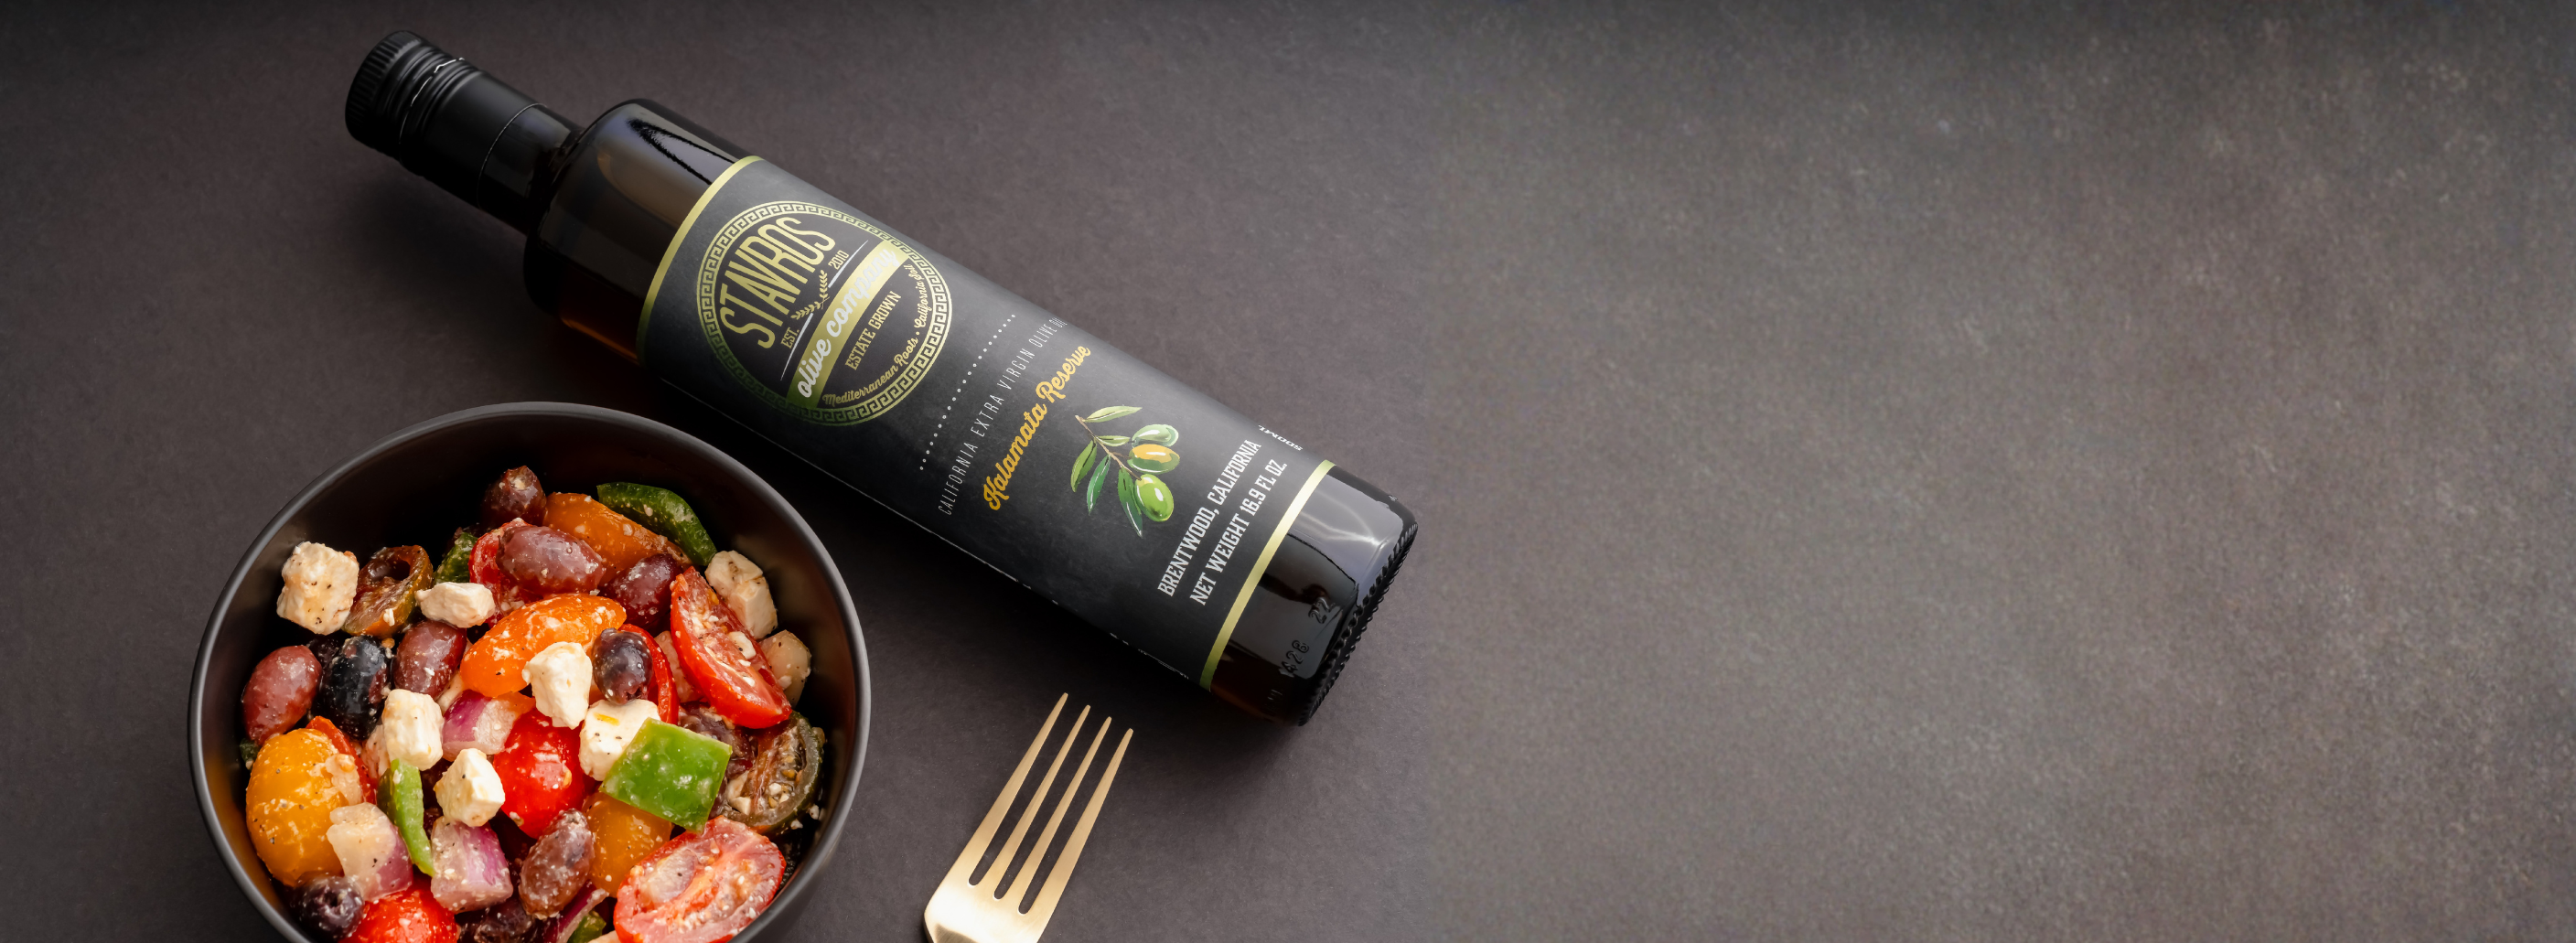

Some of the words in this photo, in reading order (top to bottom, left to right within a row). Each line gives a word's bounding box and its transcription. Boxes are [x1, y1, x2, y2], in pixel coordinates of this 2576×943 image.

[719, 217, 836, 349] STAVROS
[828, 250, 850, 270] 2010
[780, 327, 800, 349] EST.
[798, 338, 832, 398] olive
[826, 248, 900, 338] company
[822, 365, 899, 407] Mediterranean
[894, 337, 918, 367] Roots
[914, 281, 932, 328] California
[844, 327, 876, 370] ESTATE
[868, 291, 902, 330] GROWN
[938, 442, 978, 515] CALIFORNIA
[971, 394, 1004, 437] EXTRA
[997, 348, 1036, 391] VIRGIN
[1028, 323, 1057, 348] OLIVE
[983, 403, 1048, 510] Kalamata
[1036, 346, 1091, 403] Reserve
[1254, 474, 1278, 492] FL
[1264, 458, 1288, 477] OZ.
[1157, 507, 1220, 597] BRENTWOOD,
[1207, 439, 1261, 506] CALIFORNIA
[1239, 488, 1267, 517] 16.9
[1205, 513, 1250, 573] WEIGHT
[1189, 572, 1217, 605] NET
